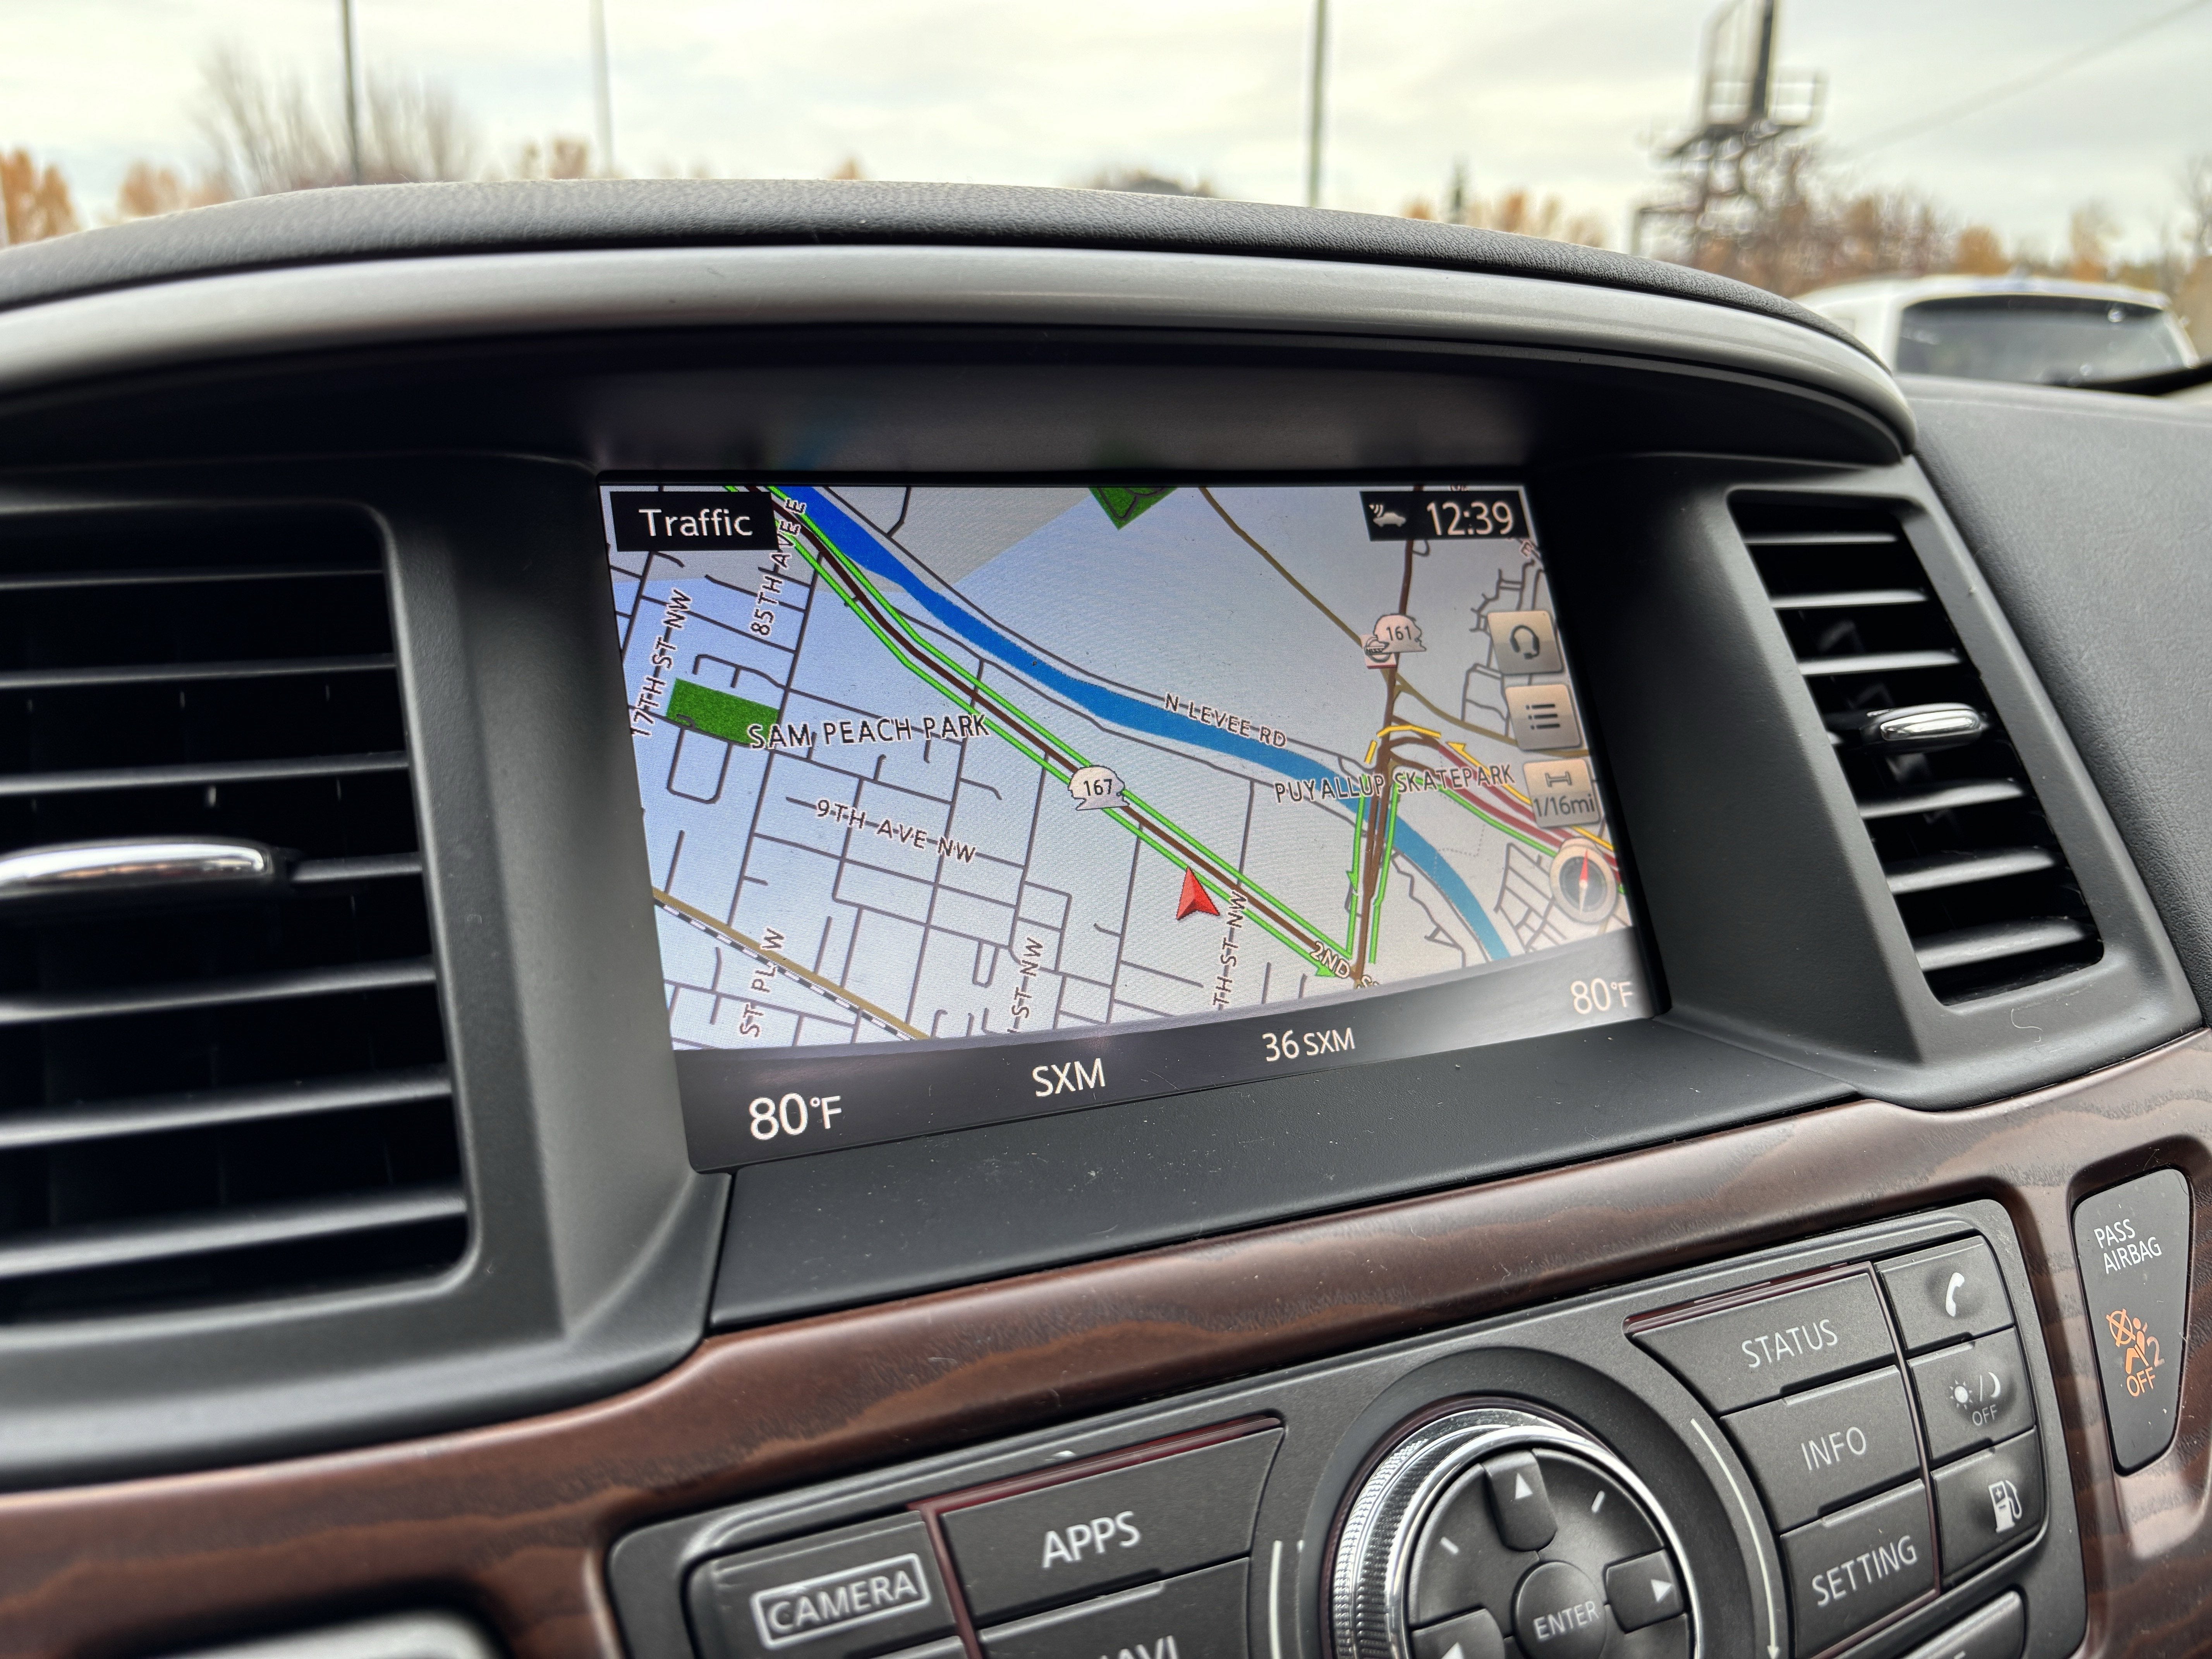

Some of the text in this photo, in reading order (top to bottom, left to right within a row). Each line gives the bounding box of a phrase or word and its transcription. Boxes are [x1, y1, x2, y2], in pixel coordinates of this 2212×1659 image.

[638, 508, 753, 536] Traffic
[1427, 501, 1513, 536] 12:39
[751, 499, 805, 636] 85TH AVE E
[663, 589, 691, 629] NW
[1386, 626, 1412, 641] 161
[653, 637, 677, 669] ST
[748, 714, 990, 749] SAM PEACH PARK
[1164, 693, 1287, 747] N LEVEE RD
[1084, 779, 1113, 795] 167
[1276, 764, 1515, 803] PUYALLUP SKATEPARK
[1533, 793, 1595, 817] 1/16mi
[817, 800, 976, 863] 9TH AVE NW
[1226, 890, 1247, 928] NW
[1019, 937, 1043, 977] NW
[1221, 937, 1239, 967] ST
[1309, 941, 1350, 979] 2ND
[740, 927, 785, 1038] ST PL W
[1571, 977, 1633, 1015] 80°F
[1011, 986, 1032, 1019] ST
[1262, 1027, 1356, 1062] 36 SXM
[1032, 1058, 1106, 1097] SXM
[749, 1093, 842, 1140] 80°F
[2094, 1218, 2136, 1249] PASS
[2103, 1237, 2162, 1274] AIRBAG
[1741, 1319, 1838, 1368] STATUS
[2126, 1367, 2155, 1397] OFF
[1972, 1404, 1998, 1426] OFF
[1801, 1426, 1867, 1471] INFO
[1042, 1510, 1141, 1569] APPS
[1811, 1535, 1917, 1608] SETTING
[767, 1570, 919, 1633] CAMERA
[1533, 1600, 1600, 1640] ENTER
